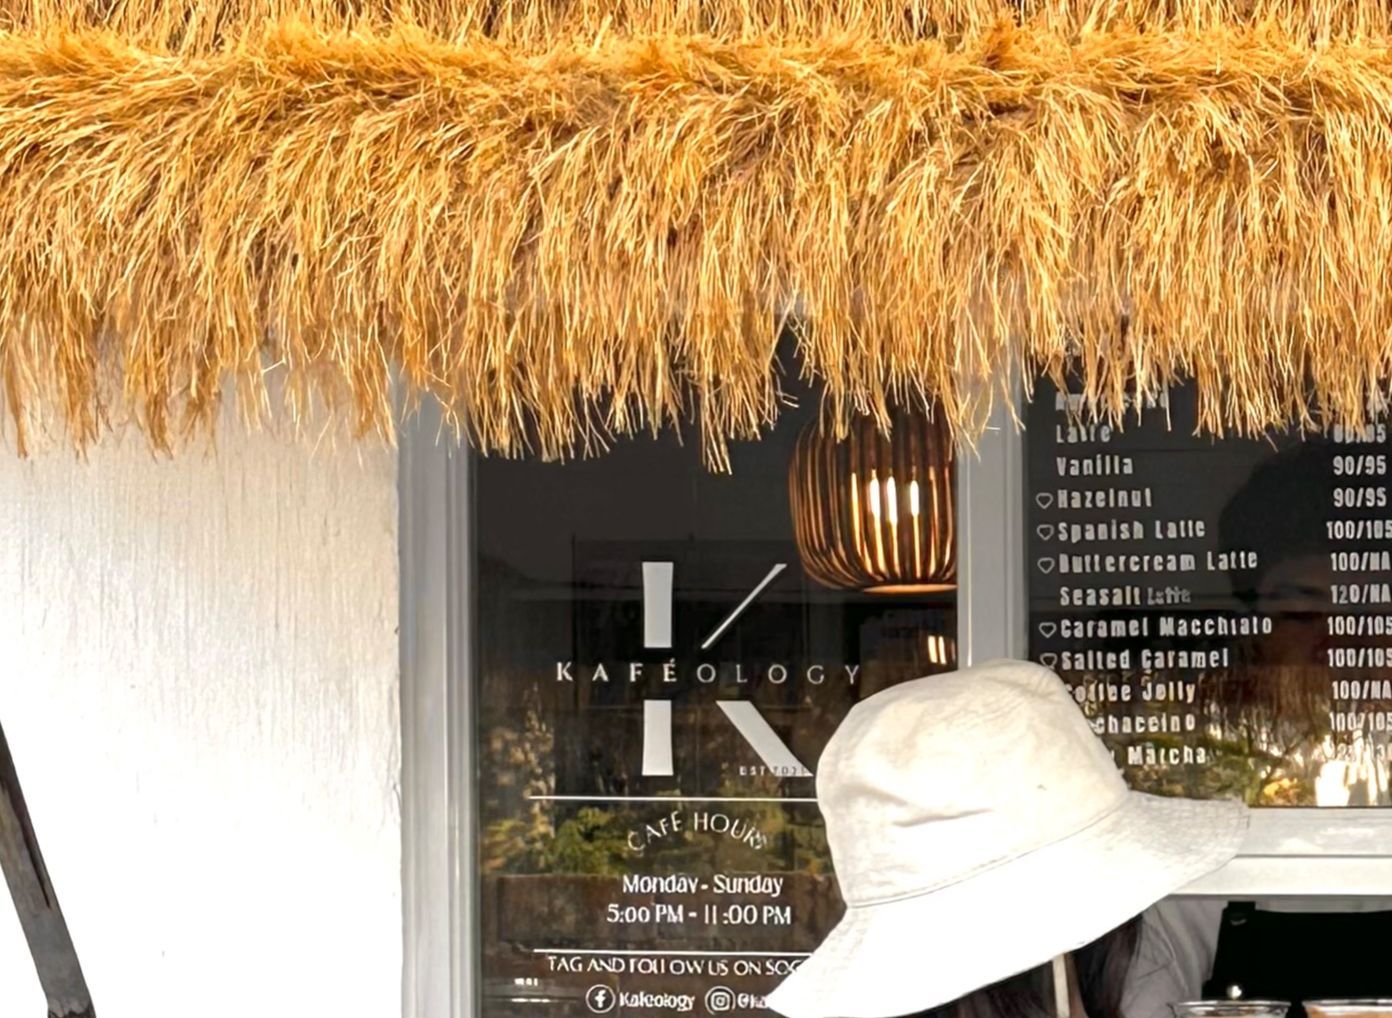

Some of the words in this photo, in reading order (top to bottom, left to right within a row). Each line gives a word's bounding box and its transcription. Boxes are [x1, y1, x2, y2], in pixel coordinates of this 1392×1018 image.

[1057, 454, 1133, 476] Vanilla
[1333, 455, 1387, 476] 90/95
[1057, 488, 1152, 508] Hazelnut
[1333, 488, 1387, 507] 90/95
[1058, 519, 1144, 543] Spanish
[1155, 520, 1205, 538] Latte
[1059, 552, 1195, 573] Buttercream
[1207, 551, 1258, 570] Latte
[1330, 551, 1391, 571] 100/NA
[1060, 586, 1141, 607] Seasalt
[1331, 584, 1391, 605] 120/NA
[1061, 617, 1148, 639] Caramel
[1159, 617, 1272, 636] Macchiato
[1062, 650, 1130, 670] Salted
[1142, 649, 1229, 669] Caramel
[1066, 683, 1131, 702] offee
[1142, 679, 1195, 704] Jelly
[1331, 681, 1392, 699] 100/NA
[1094, 713, 1195, 734] chaccino
[1128, 747, 1206, 765] Matcha
[713, 874, 784, 898] Sunday
[606, 903, 650, 923] 5:00
[655, 904, 684, 923] PM
[705, 904, 758, 925] 11:00
[763, 905, 792, 925] PM
[548, 956, 583, 973] TAG
[586, 956, 626, 974] AND
[708, 959, 729, 976] US
[734, 960, 762, 976] ON
